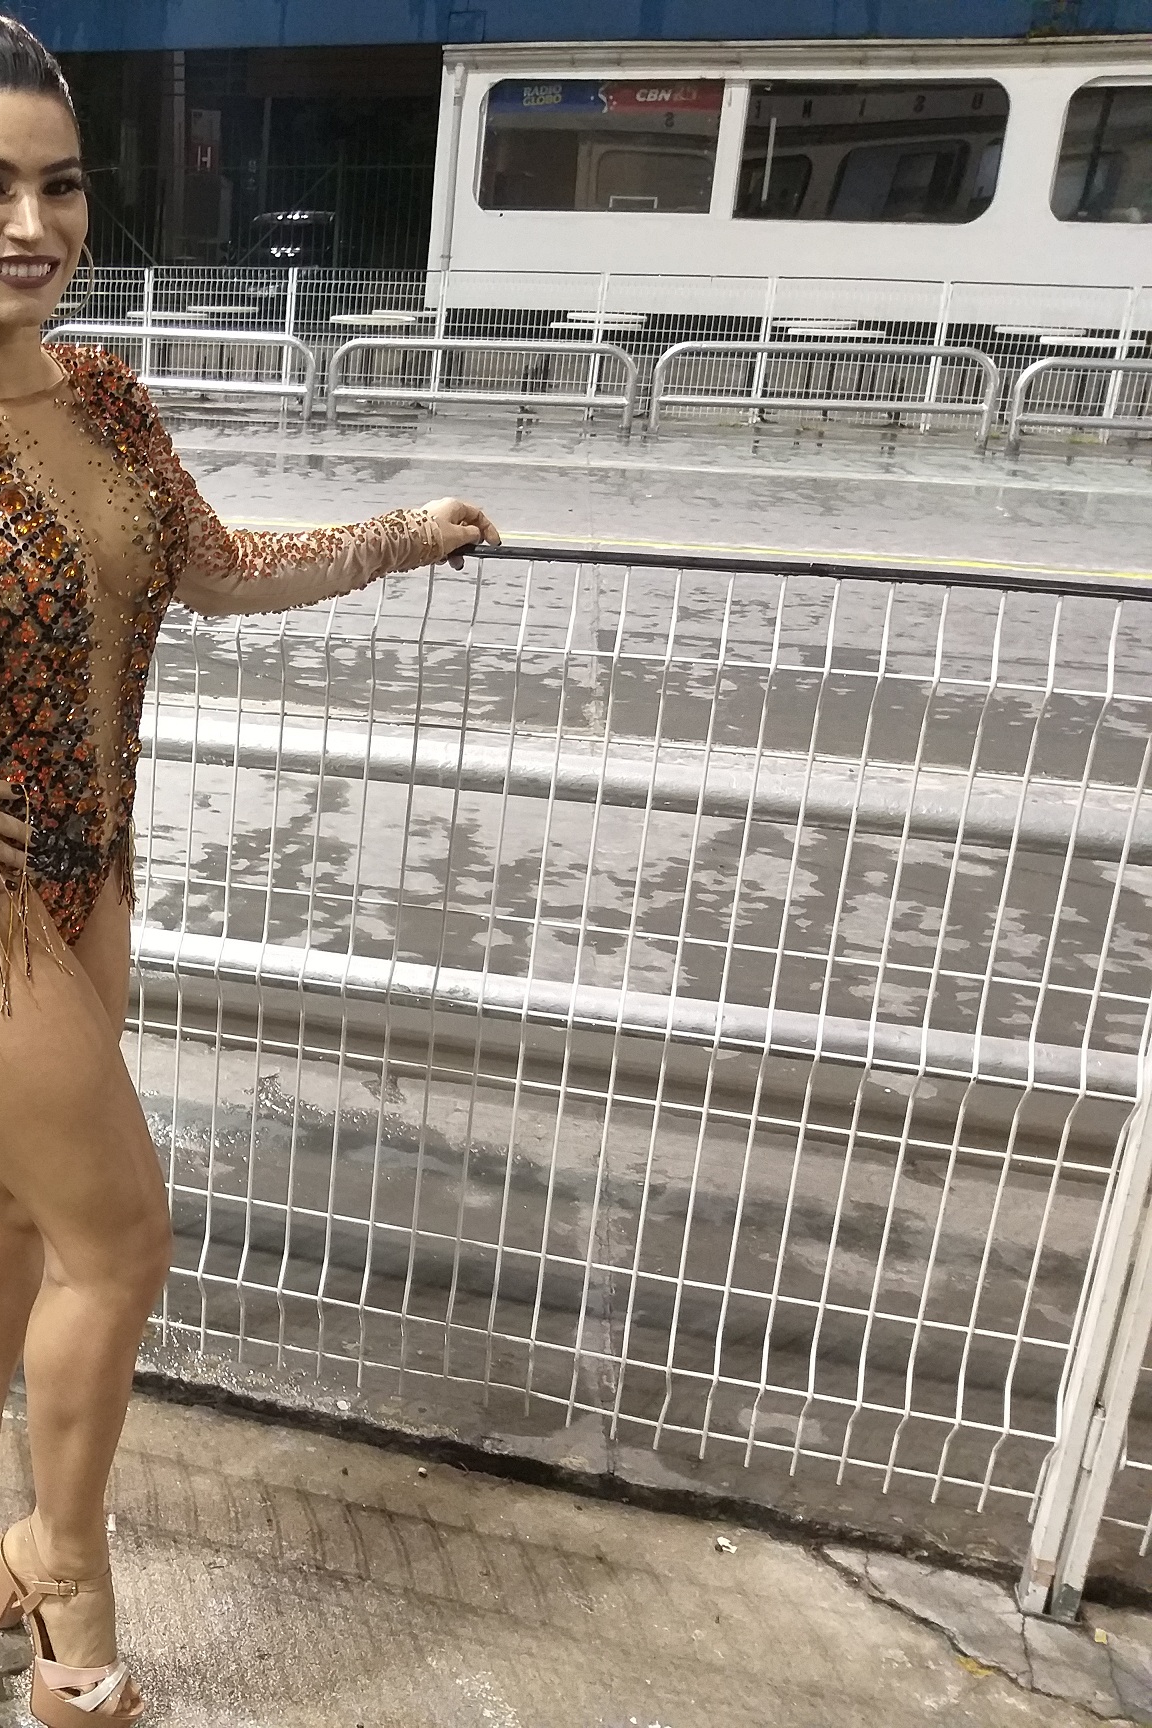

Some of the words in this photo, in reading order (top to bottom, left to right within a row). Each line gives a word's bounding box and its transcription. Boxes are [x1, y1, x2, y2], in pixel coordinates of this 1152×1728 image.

[523, 94, 562, 106] GLOBO
[636, 88, 672, 102] CBN
[197, 146, 211, 171] H
